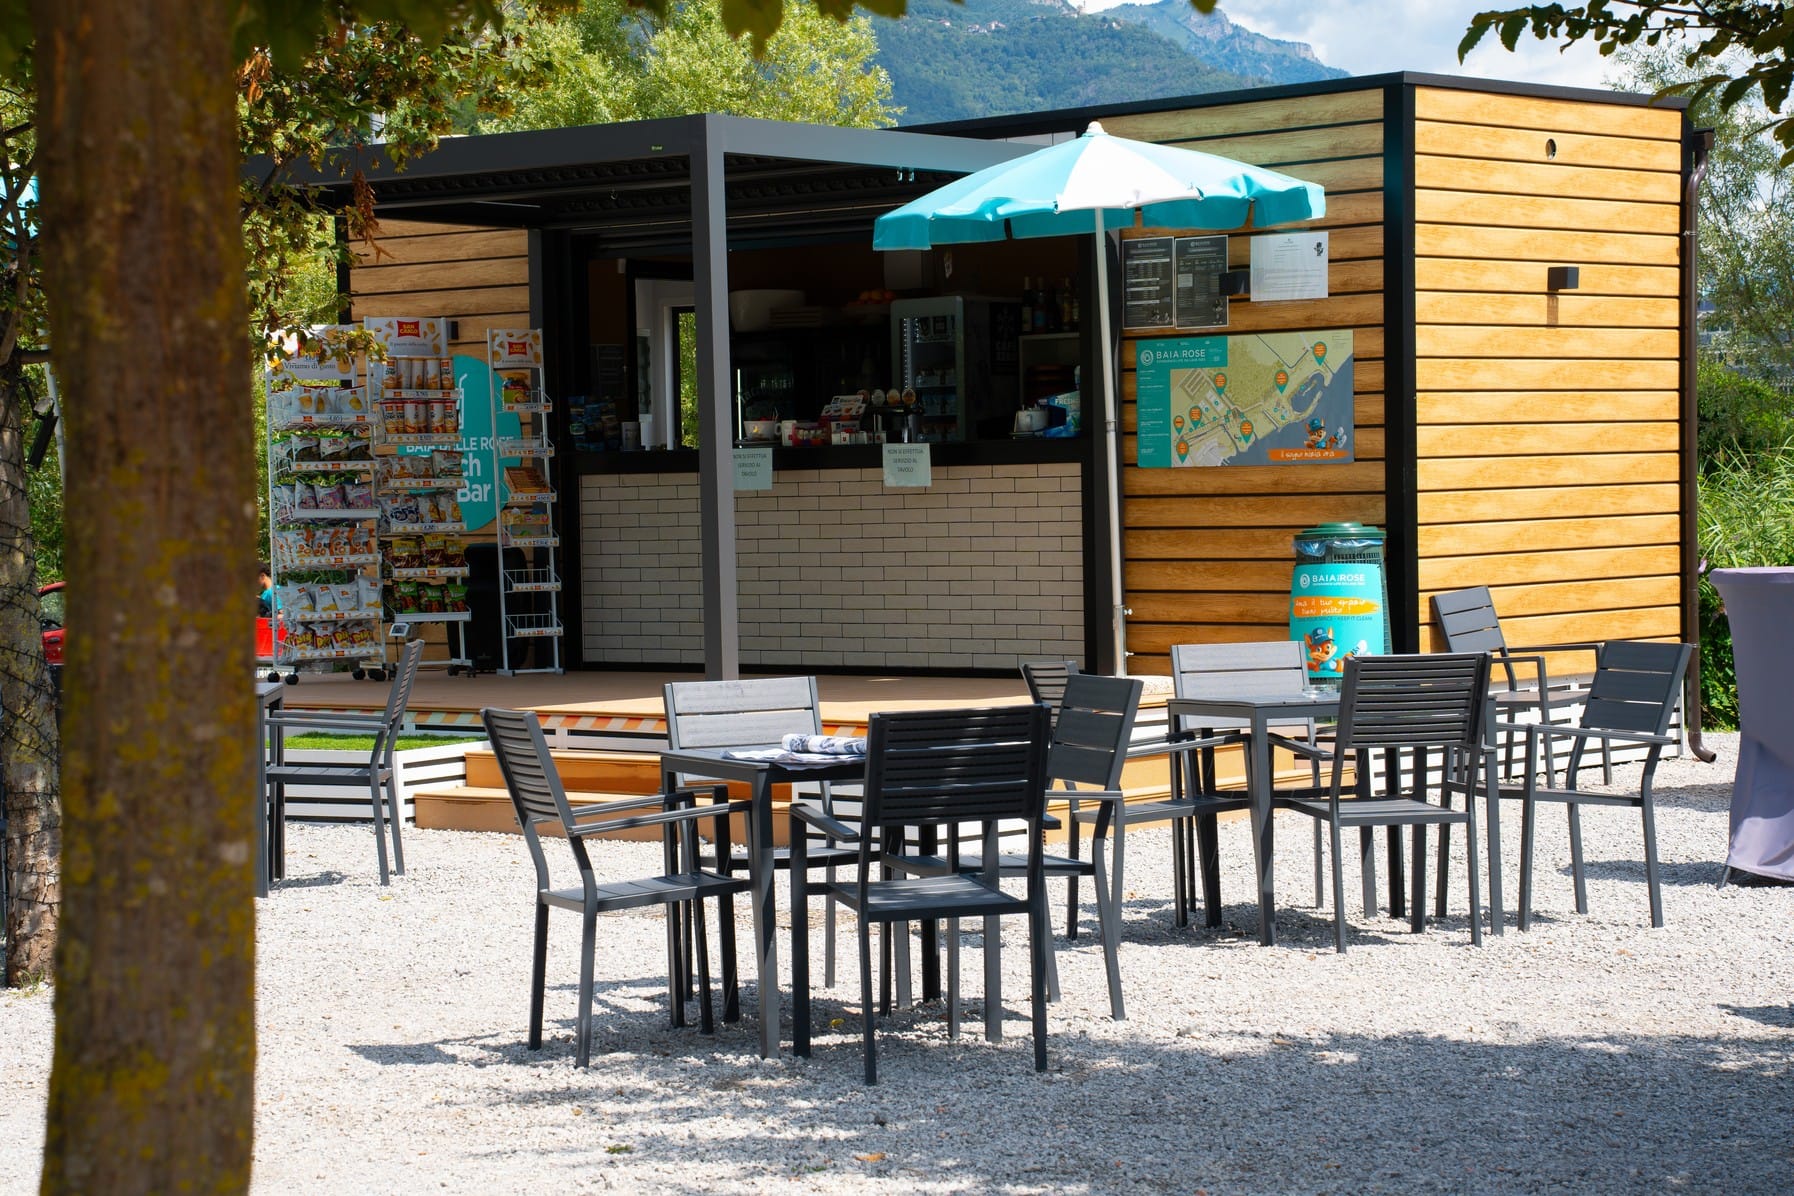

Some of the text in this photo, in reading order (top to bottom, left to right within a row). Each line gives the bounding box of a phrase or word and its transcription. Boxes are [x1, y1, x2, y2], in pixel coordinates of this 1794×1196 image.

[1156, 350, 1179, 360] BAIA
[1182, 349, 1206, 358] ROSE
[456, 479, 491, 503] Bar
[1312, 573, 1365, 582] BAIA ROSE
